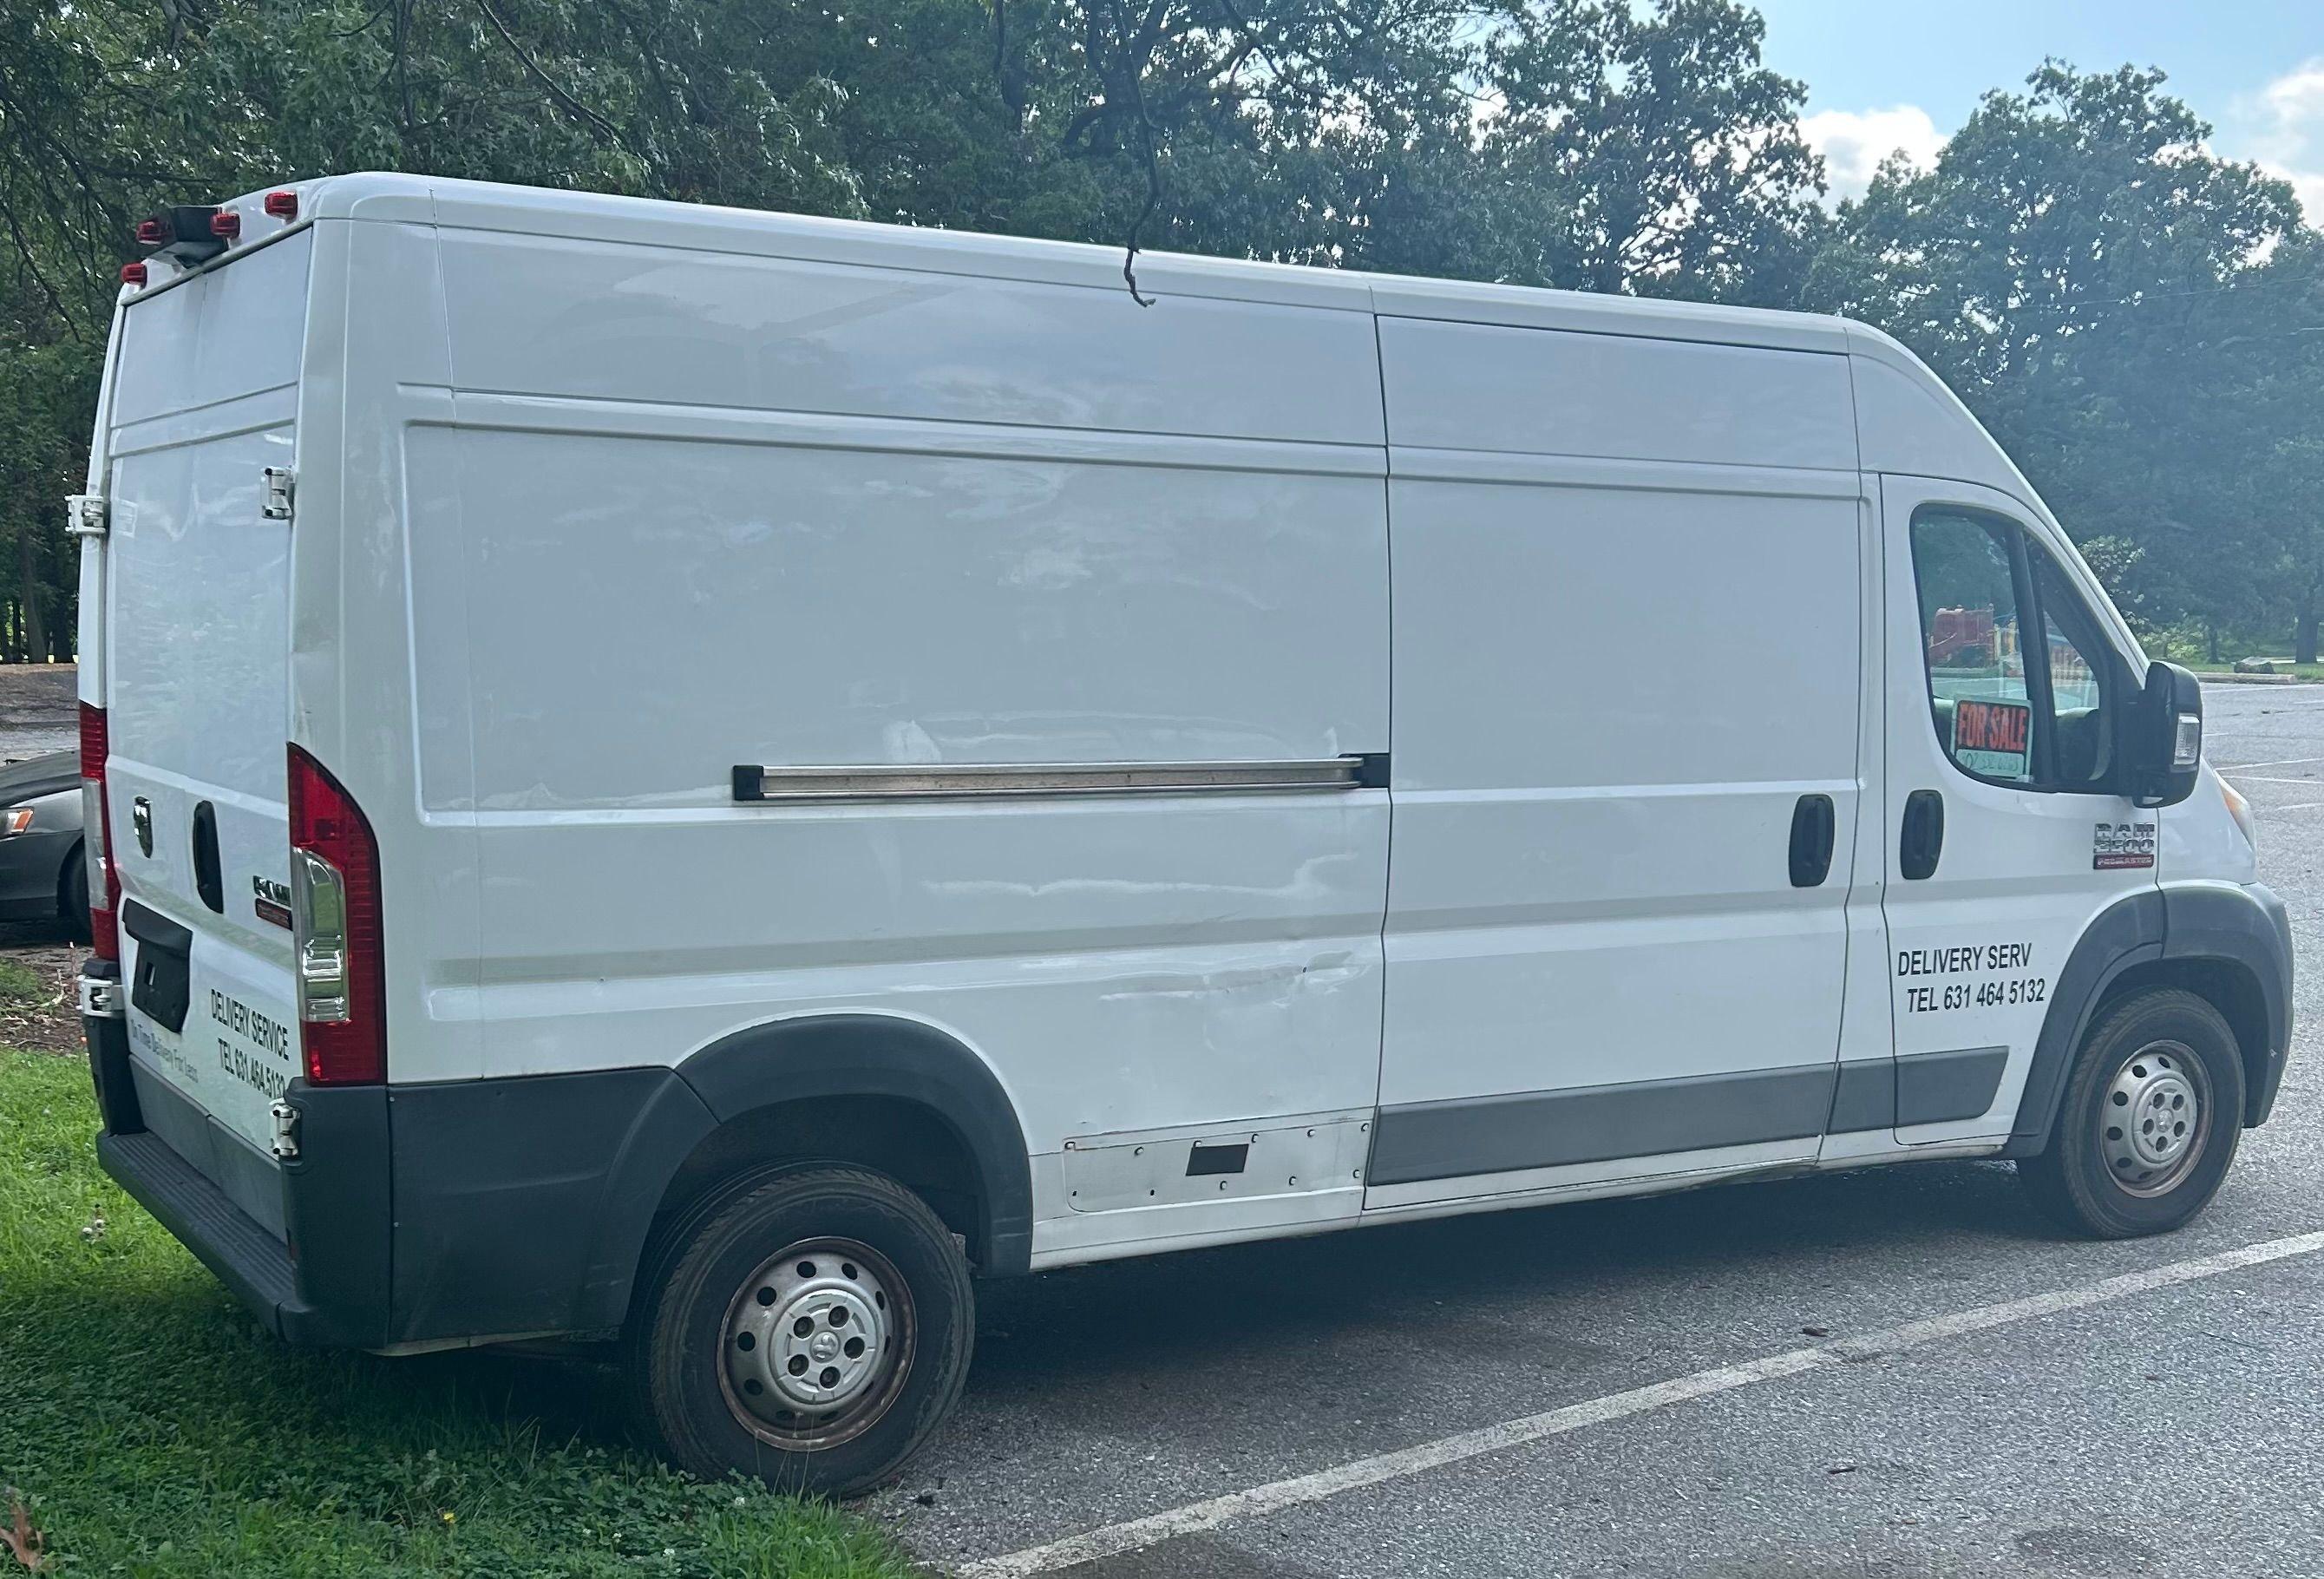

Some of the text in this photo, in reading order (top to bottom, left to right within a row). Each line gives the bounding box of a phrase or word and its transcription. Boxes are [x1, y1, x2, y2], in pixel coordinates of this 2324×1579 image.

[1957, 704, 2027, 751] FOR SALE
[2095, 823, 2155, 839] RAM
[1897, 942, 2033, 976] DELIVERY SERV
[1907, 978, 2046, 1013] TEL 631 464 5132
[211, 988, 289, 1061] DELIVERY SERVICE
[218, 1038, 235, 1075] TEL
